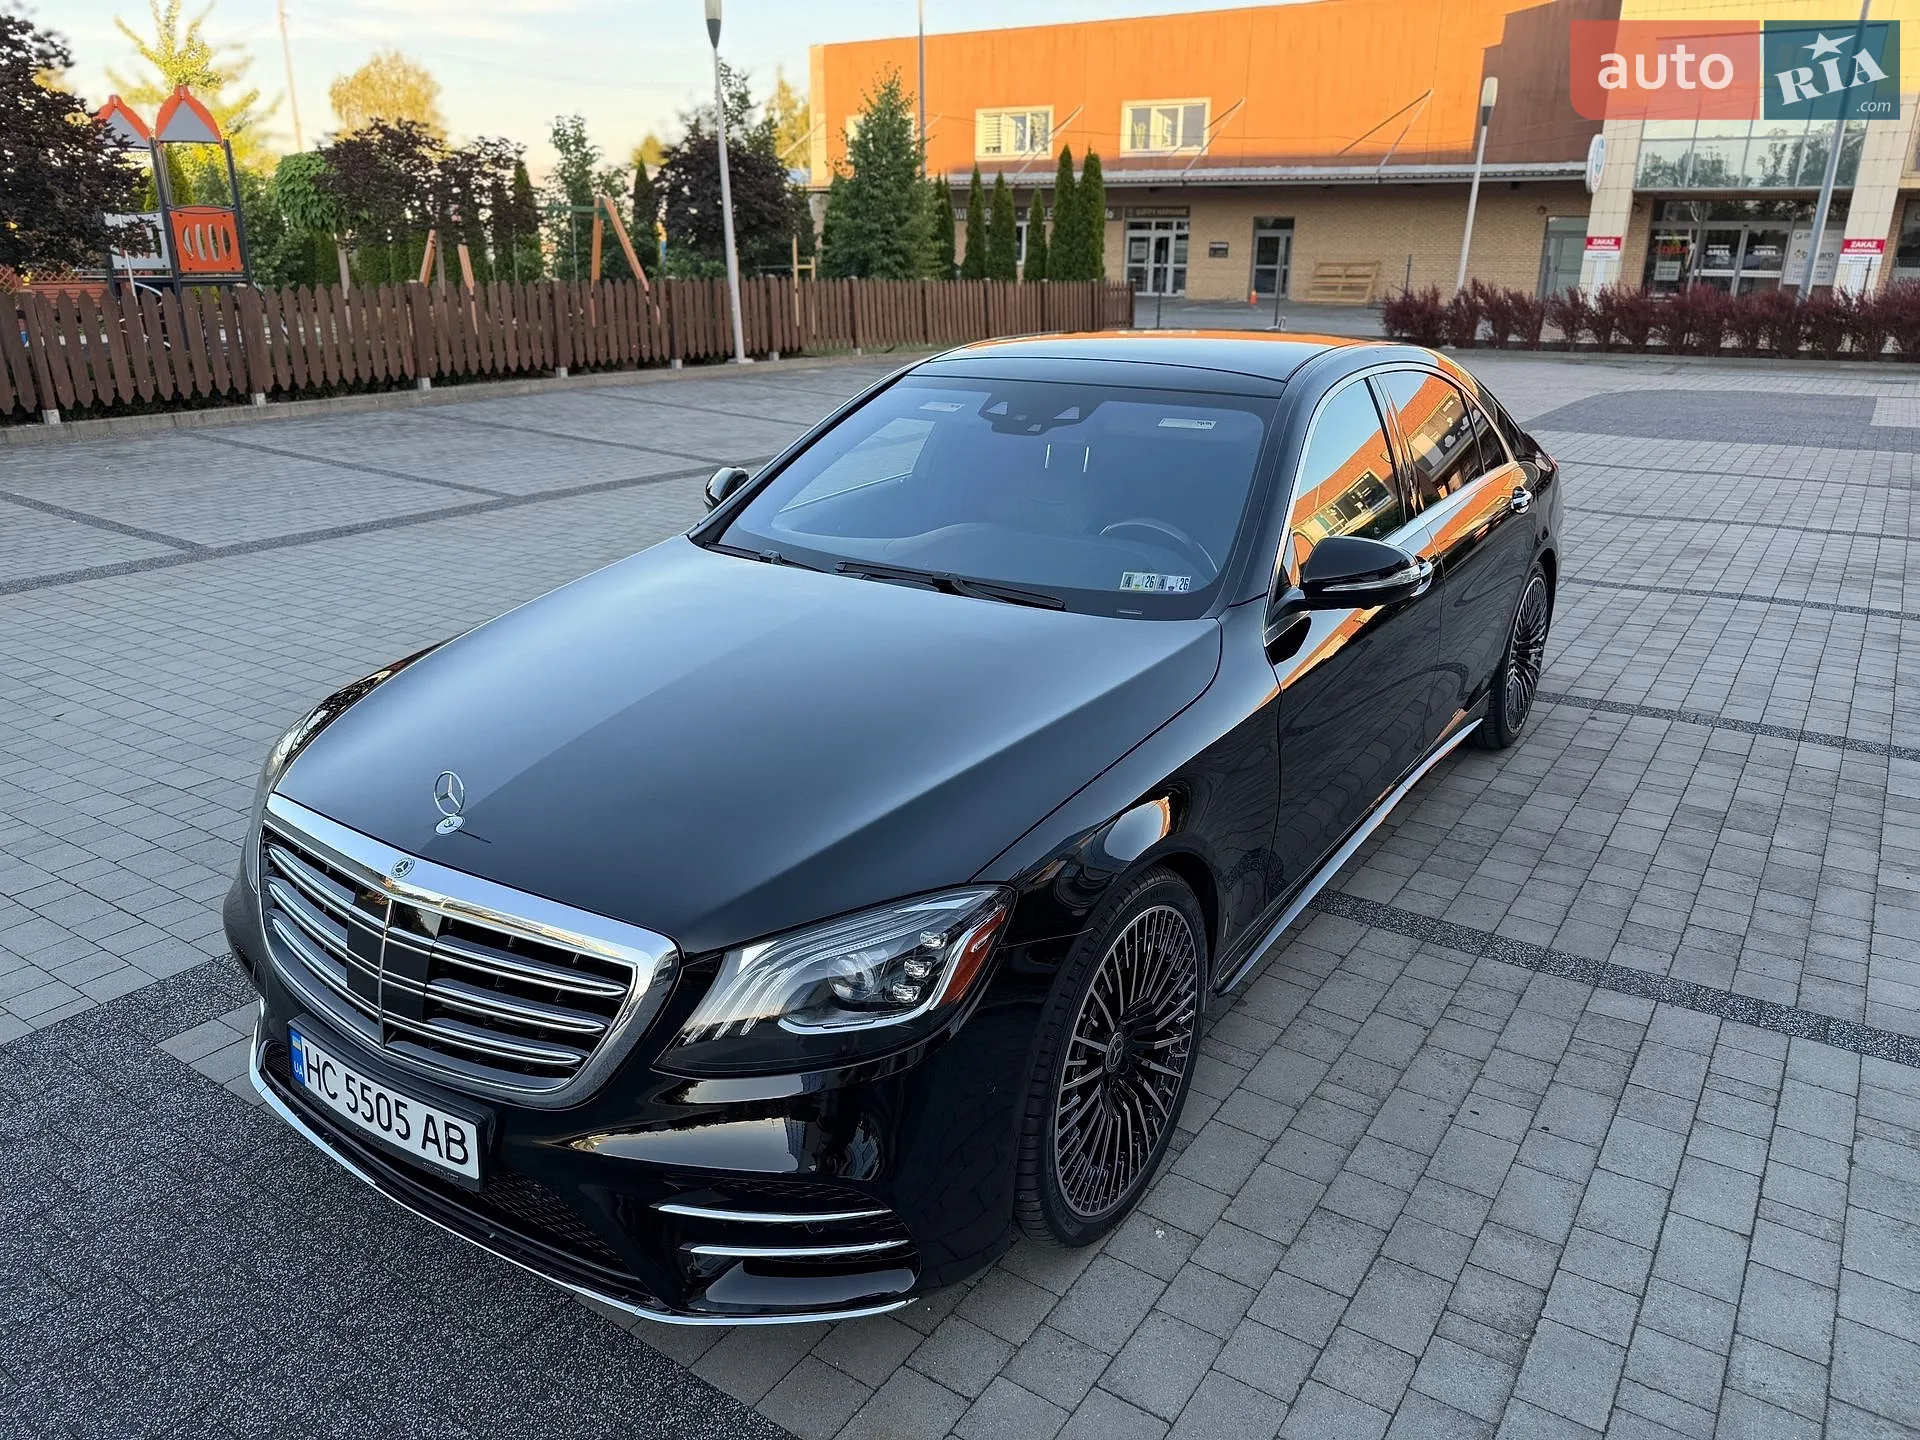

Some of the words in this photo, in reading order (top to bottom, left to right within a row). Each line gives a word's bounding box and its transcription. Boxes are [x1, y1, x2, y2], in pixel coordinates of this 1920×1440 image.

[1849, 240, 1878, 248] ZAKAZ
[294, 1061, 304, 1078] UA
[304, 1046, 338, 1100] HC
[344, 1074, 411, 1141] 5505
[421, 1113, 469, 1165] AB
